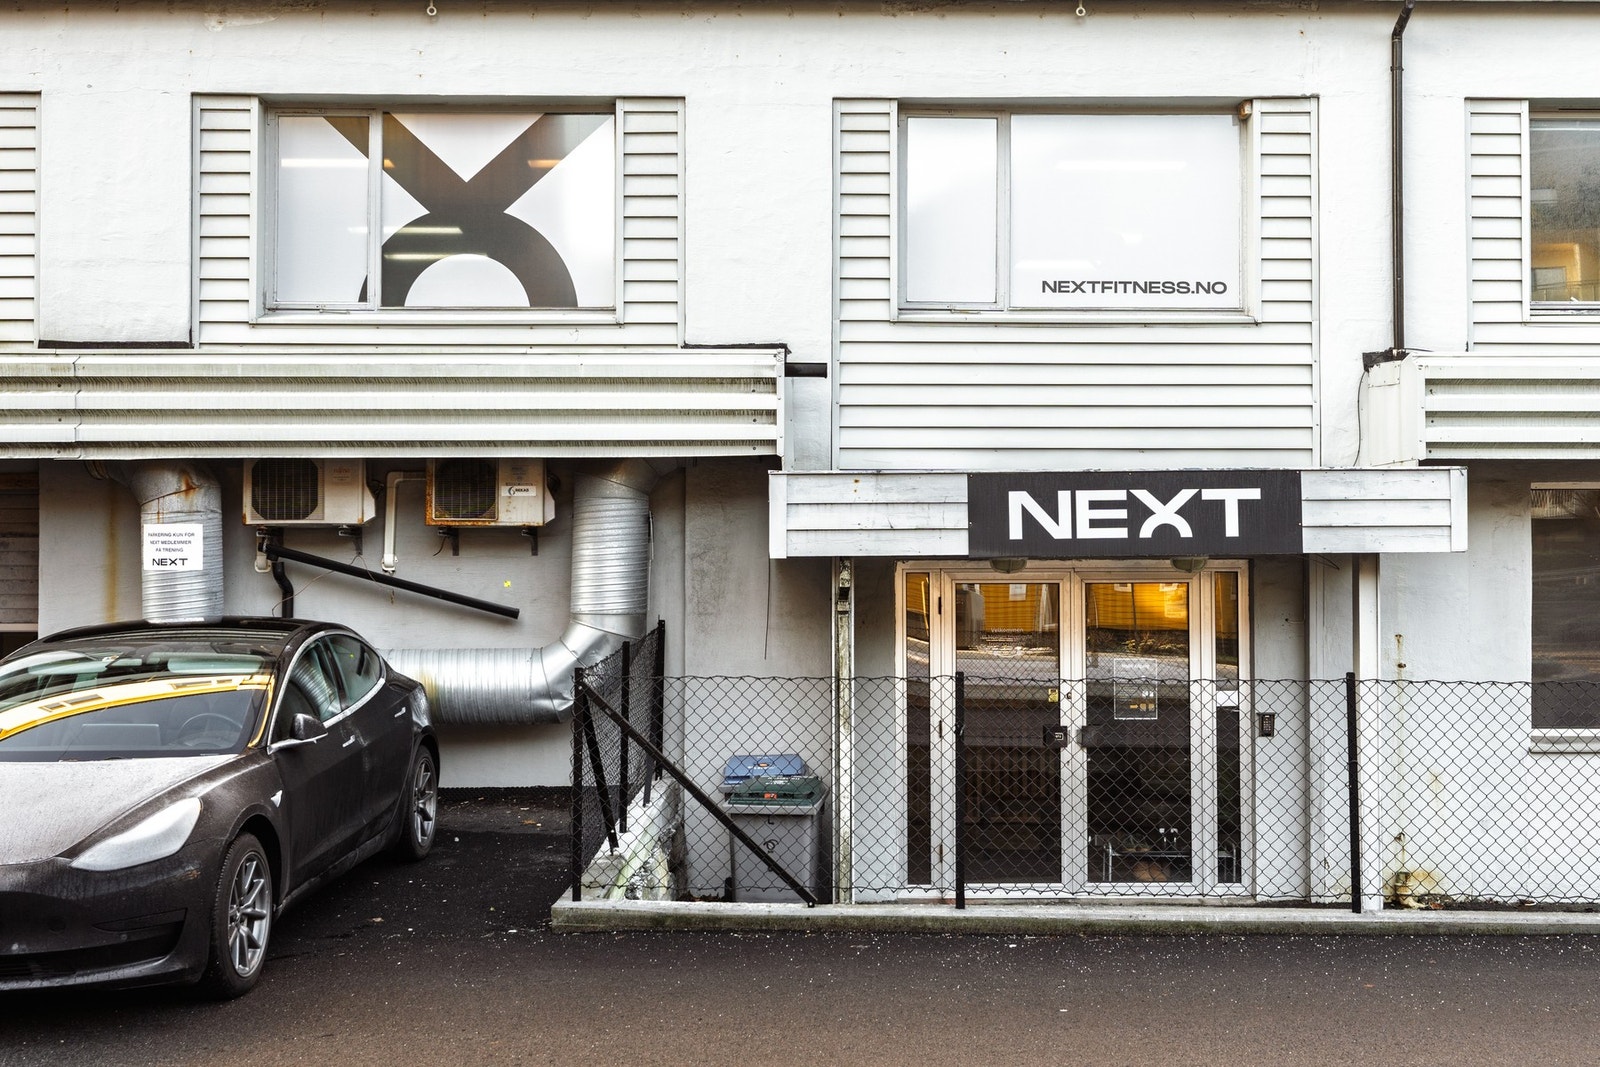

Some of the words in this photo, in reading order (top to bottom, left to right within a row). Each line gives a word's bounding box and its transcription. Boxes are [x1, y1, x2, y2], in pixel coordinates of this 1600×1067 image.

[1042, 280, 1228, 294] NEXTFITNESS.NO
[1008, 488, 1262, 540] NEXT
[152, 558, 188, 566] NEXT
